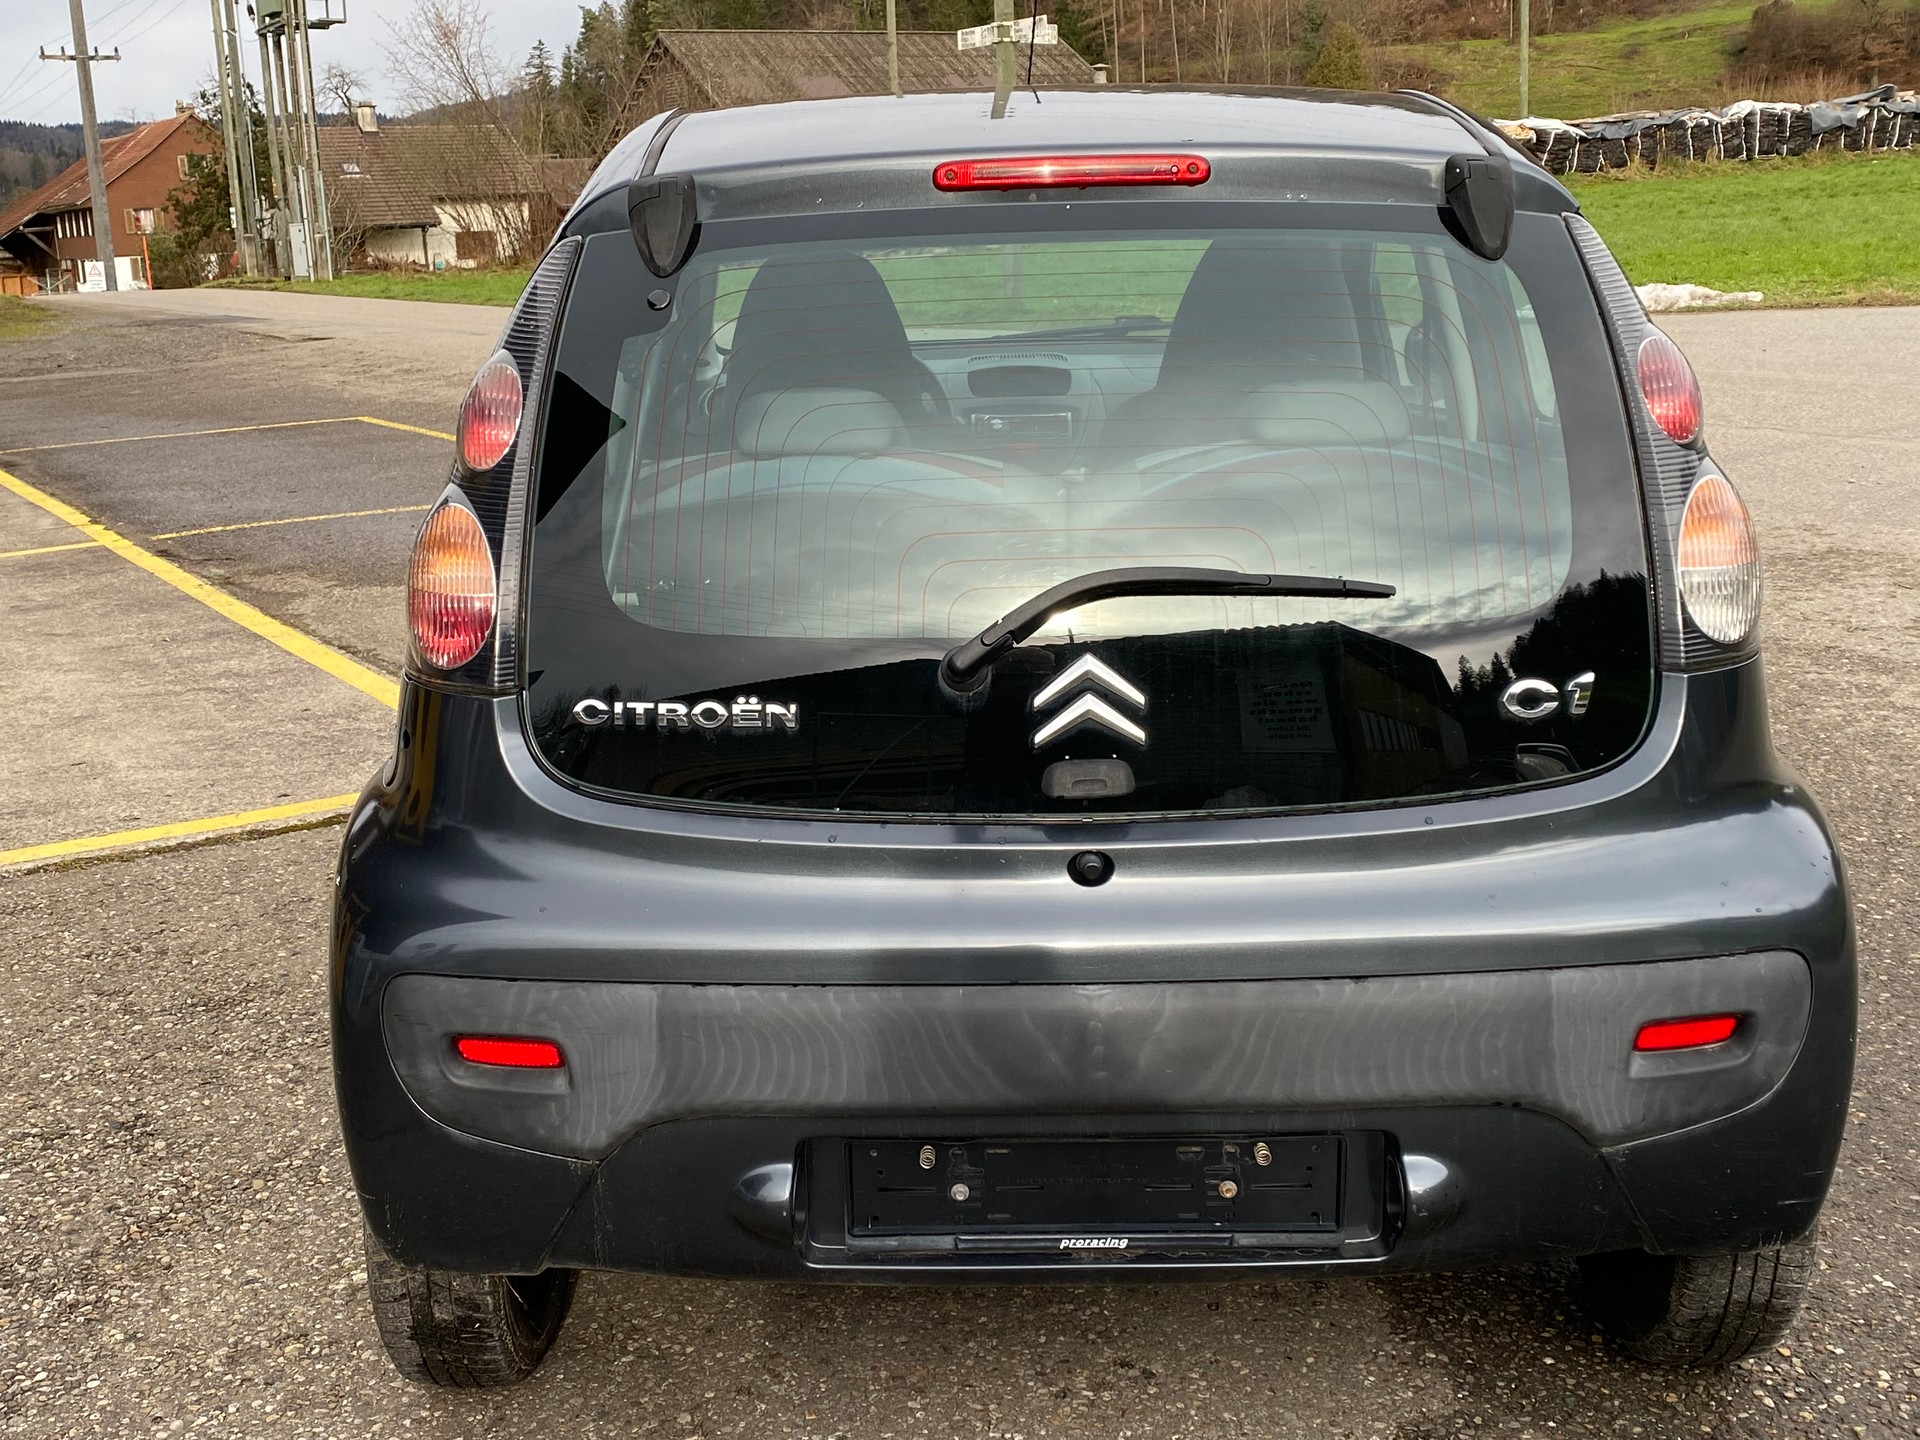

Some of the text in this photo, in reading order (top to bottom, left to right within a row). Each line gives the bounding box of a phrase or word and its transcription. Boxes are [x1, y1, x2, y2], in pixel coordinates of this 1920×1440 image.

[1500, 670, 1596, 719] C1
[572, 695, 798, 729] CITROËN
[1059, 1237, 1129, 1250] proracing
